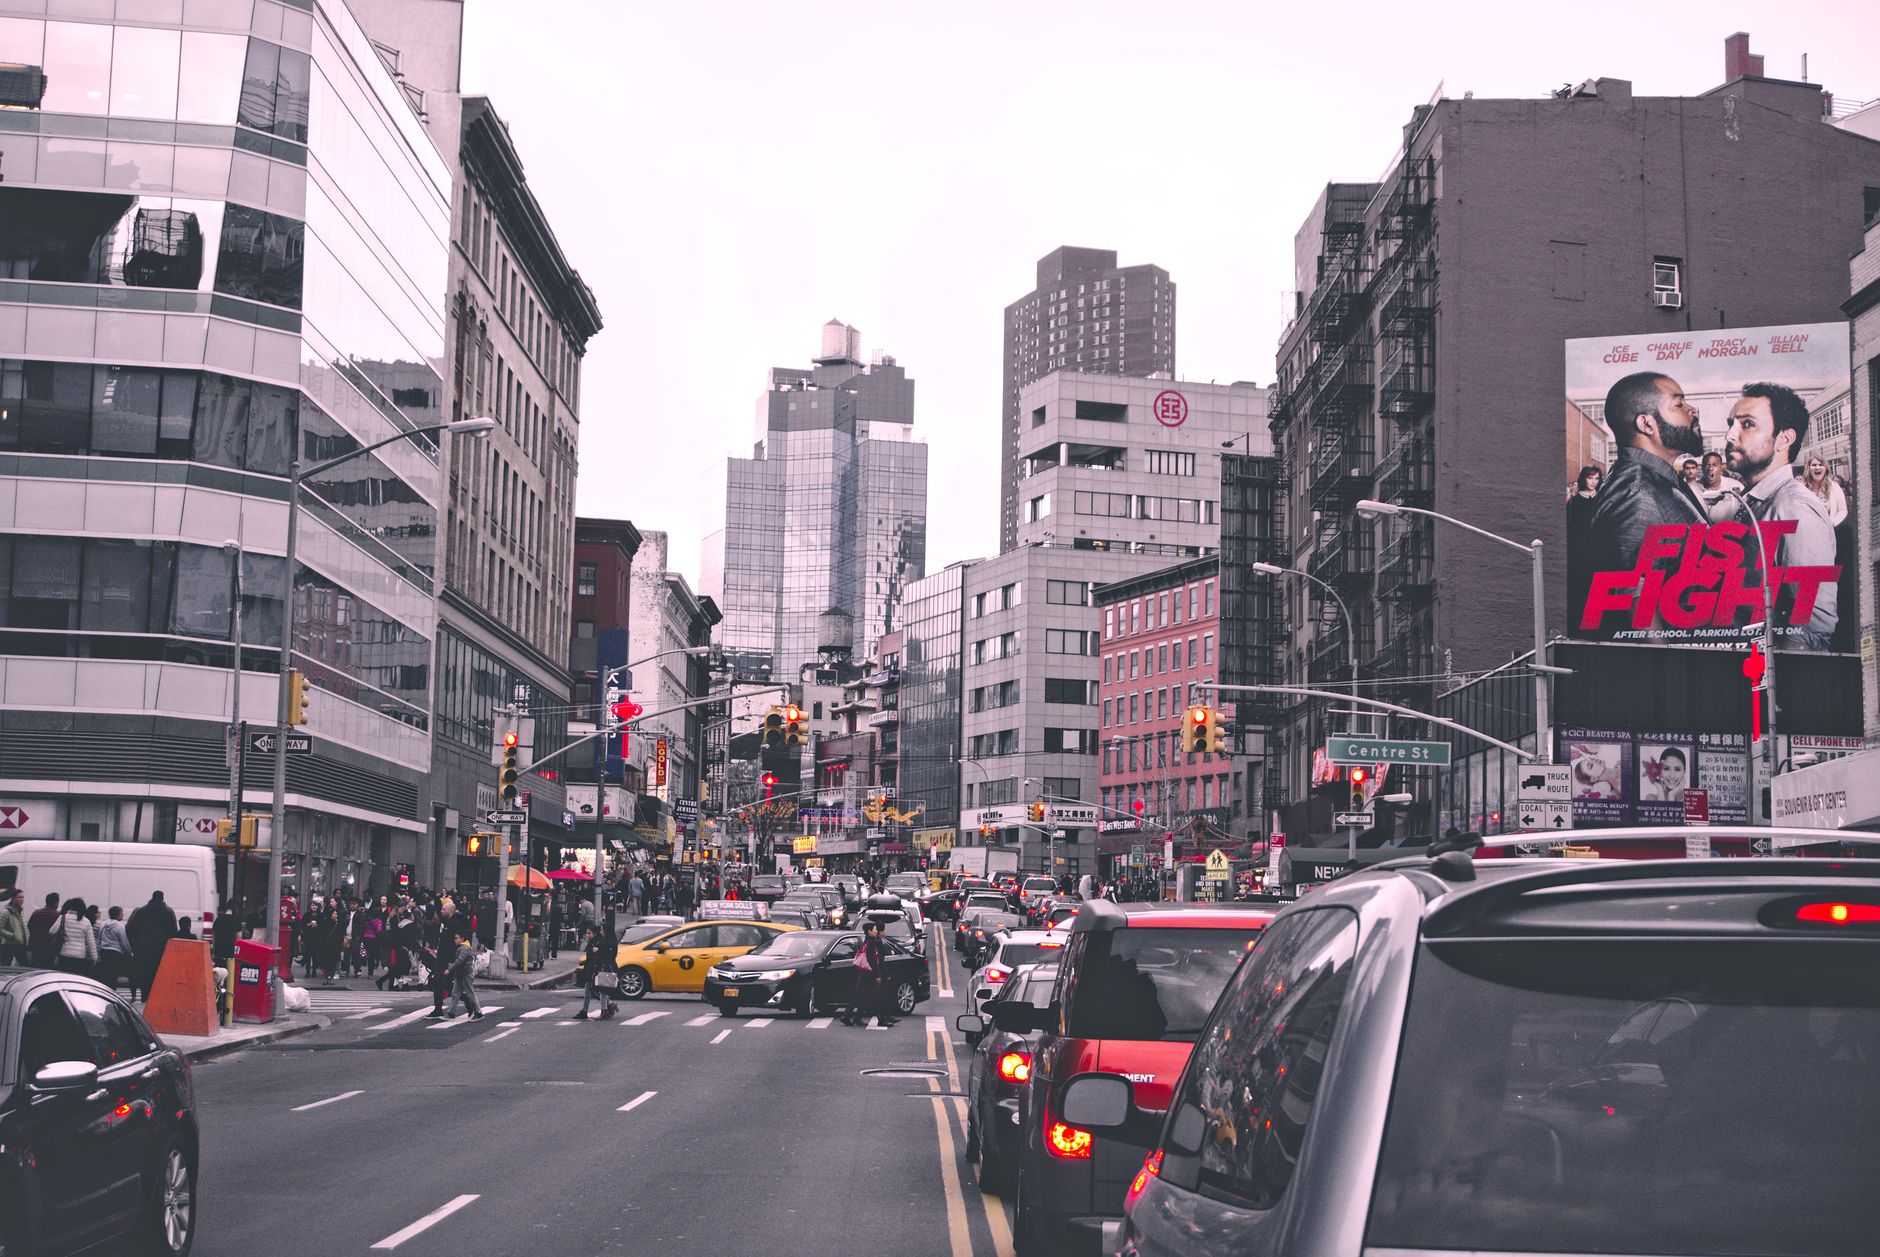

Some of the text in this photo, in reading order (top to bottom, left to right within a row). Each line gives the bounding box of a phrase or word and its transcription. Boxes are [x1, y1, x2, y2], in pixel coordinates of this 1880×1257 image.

[1711, 338, 1746, 348] TRACY
[1768, 334, 1809, 345] JILLIAN
[1612, 345, 1629, 354] ICE
[1647, 341, 1693, 352] CHARLIE
[1698, 345, 1758, 359] MORGAN
[1771, 342, 1804, 354] BELL
[1603, 352, 1639, 364] CUBE
[1656, 350, 1684, 361] DAY
[1634, 520, 1799, 574] FIST
[1580, 566, 1843, 630] FIGHT
[1613, 630, 1646, 639] AFTER
[1648, 630, 1691, 639] SCHOOL.
[1693, 628, 1739, 638] PARKING
[1786, 627, 1805, 636] ON.
[1586, 730, 1615, 738] BEAUTY
[1617, 731, 1631, 739] SPA
[1699, 733, 1745, 746] 中華保險
[259, 739, 305, 749] ONE WAY
[1793, 736, 1813, 746] CELL
[1815, 736, 1843, 747] PHONE
[1348, 744, 1430, 759] Centre St
[657, 748, 666, 776] GOLD
[1547, 773, 1570, 781] TRUCK
[1547, 785, 1570, 793] ROUTE
[1520, 804, 1544, 812] LOCAL
[1550, 804, 1569, 812] THRU
[1784, 796, 1808, 816] SOUVENIR
[1825, 790, 1848, 810] CENTER
[1113, 820, 1124, 830] WEST
[1124, 820, 1136, 829] BANK
[1756, 841, 1771, 850] ONE
[682, 958, 690, 969] T
[240, 967, 259, 978] am
